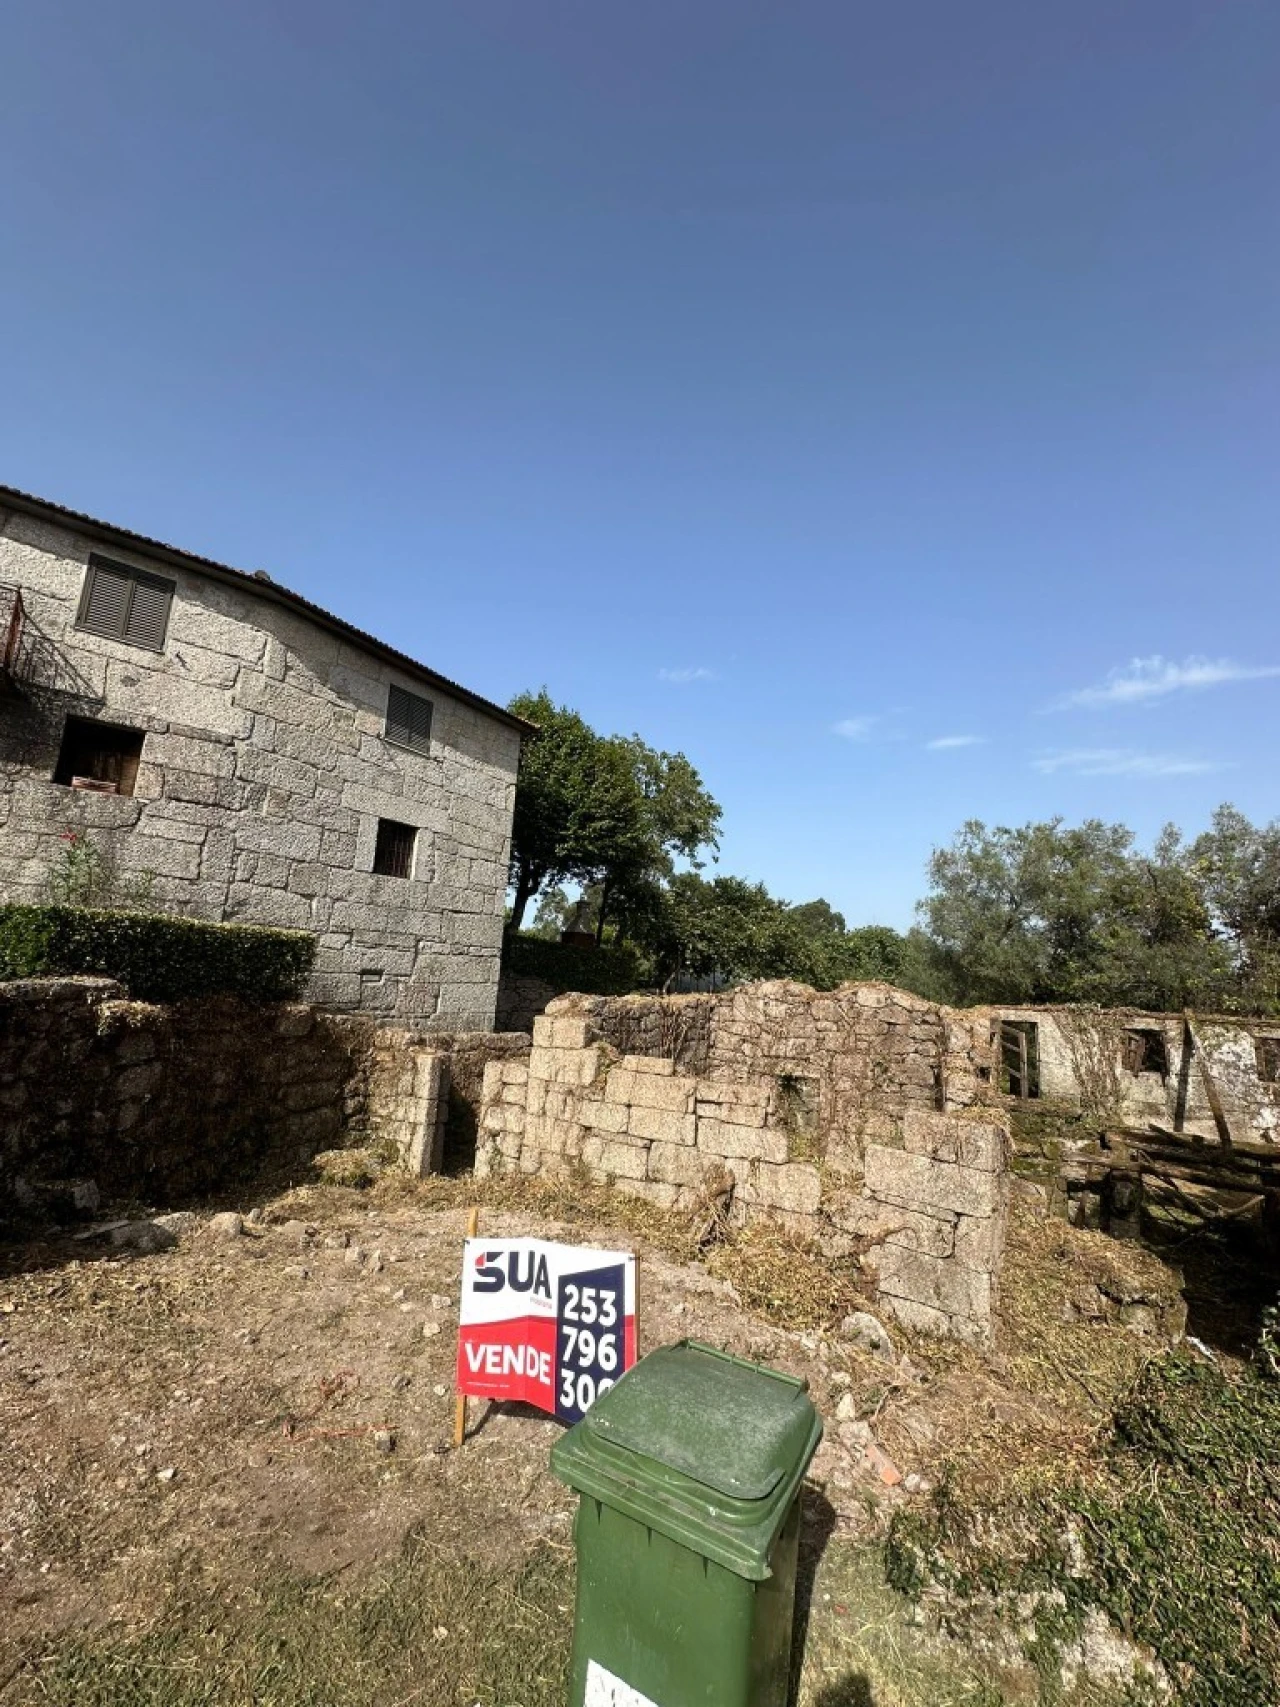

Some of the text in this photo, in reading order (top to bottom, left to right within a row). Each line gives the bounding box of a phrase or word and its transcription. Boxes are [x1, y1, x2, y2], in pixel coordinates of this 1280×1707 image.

[473, 1251, 552, 1299] SUA
[564, 1284, 617, 1326] 253
[465, 1342, 551, 1385] VENDE
[562, 1325, 617, 1371] 796
